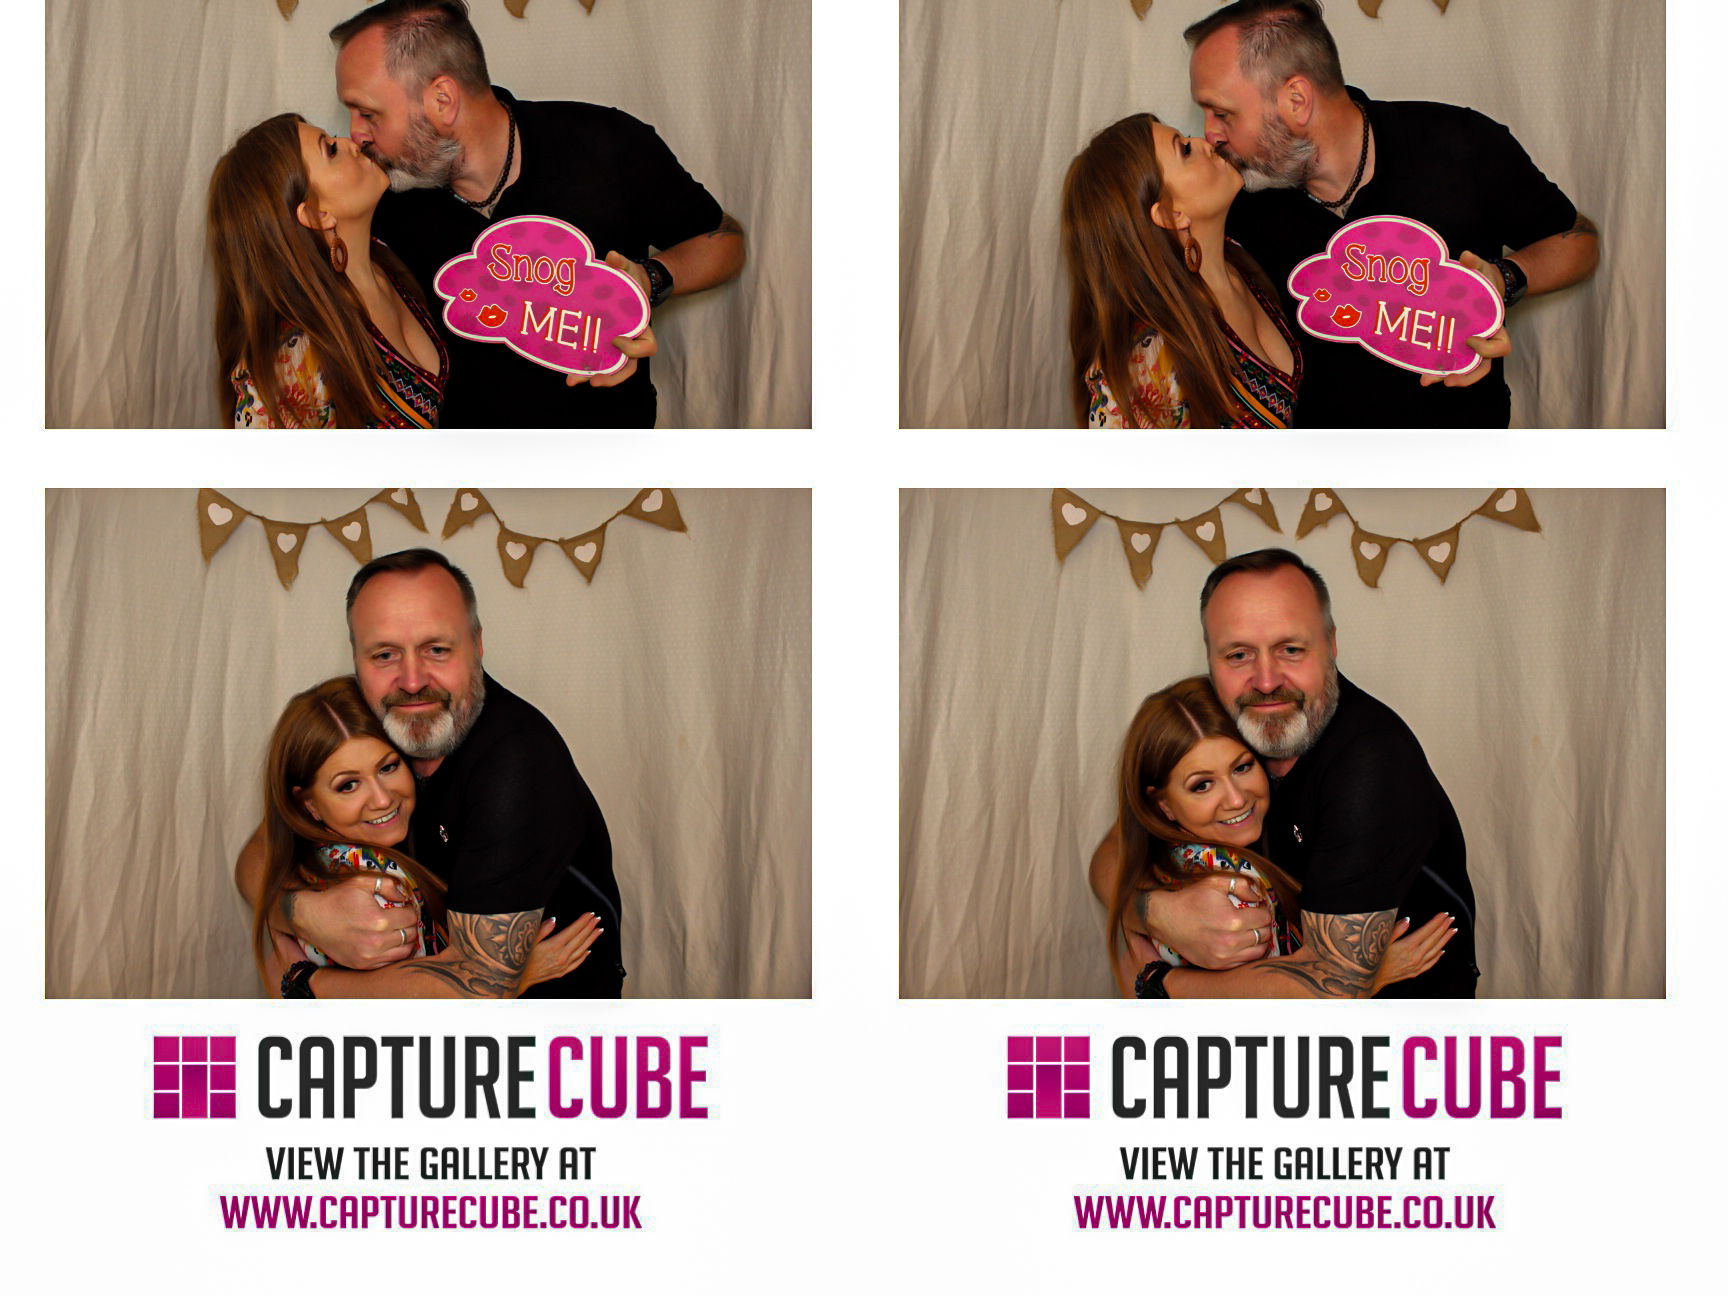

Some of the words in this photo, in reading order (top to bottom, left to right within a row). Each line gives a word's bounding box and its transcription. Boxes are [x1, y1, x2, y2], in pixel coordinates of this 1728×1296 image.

[487, 243, 576, 296] Snog
[1341, 243, 1430, 296] Snog
[520, 300, 601, 354] ME!!
[1374, 300, 1455, 354] ME!!
